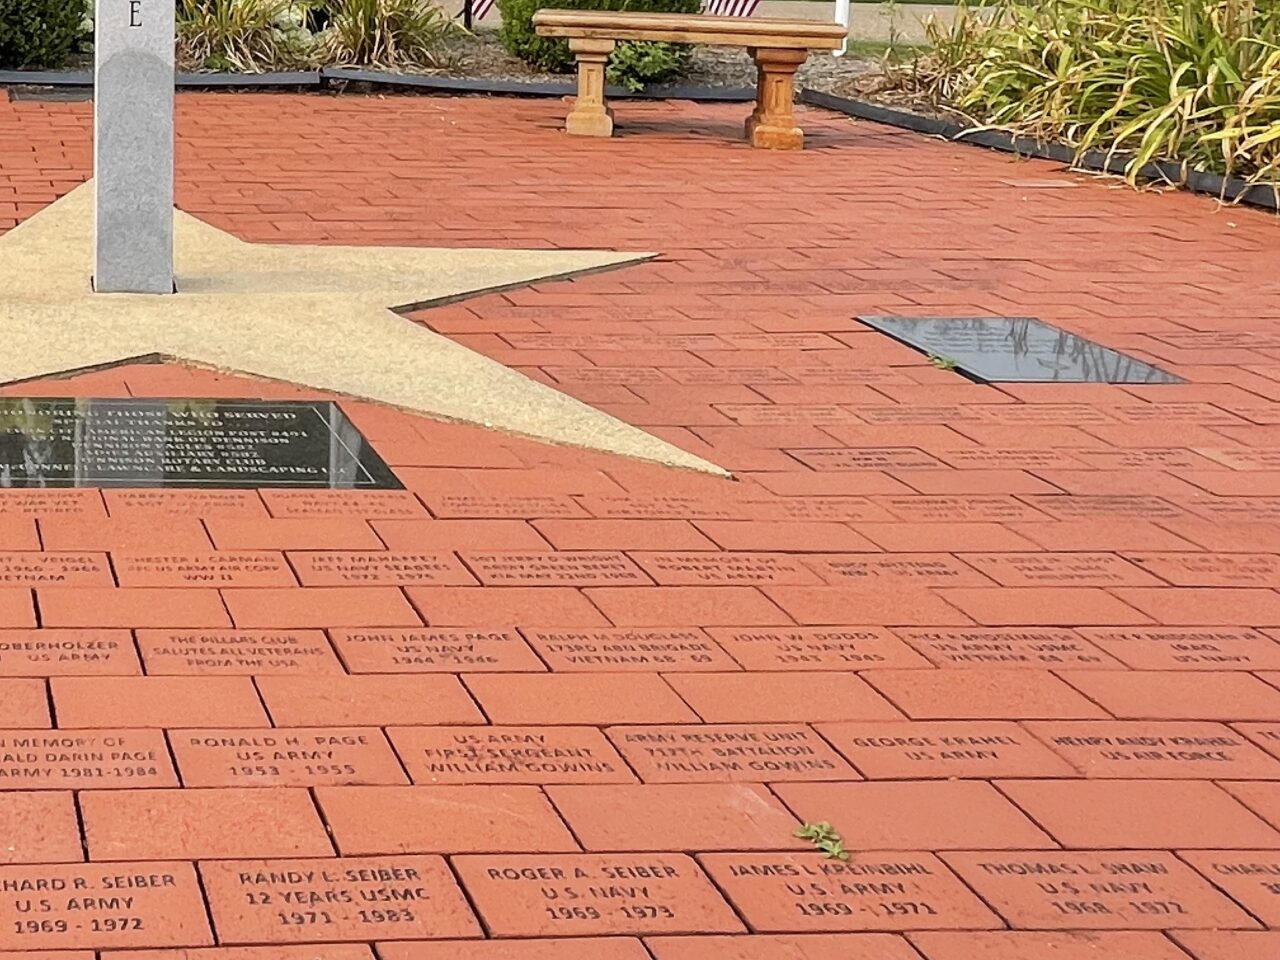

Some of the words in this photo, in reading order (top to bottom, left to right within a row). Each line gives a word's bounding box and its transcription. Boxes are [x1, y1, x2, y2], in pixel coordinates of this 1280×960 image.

[106, 410, 164, 418] THOSE
[223, 411, 296, 419] SERVED
[128, 419, 196, 427] THANKS
[89, 428, 166, 436] AMERICAN
[170, 429, 225, 437] LEGION
[207, 465, 318, 474] LANDSCAPING
[12, 736, 97, 749] MEMORY
[103, 737, 127, 748] OF
[315, 735, 369, 747] PAGE
[111, 751, 158, 762] PAGE
[236, 752, 266, 762] US
[273, 750, 335, 761] ARMY
[240, 870, 315, 886] RANDY
[345, 867, 420, 883] SEIBER
[487, 866, 564, 880] ROGER
[602, 865, 681, 879] SEIBER
[102, 875, 177, 889] SEIBER
[246, 892, 272, 906] 12
[279, 889, 354, 904] YEARS
[360, 887, 431, 902] USMC
[591, 886, 652, 899] NAVY
[840, 883, 907, 897] ARMY
[66, 897, 135, 911] ARMY
[14, 920, 69, 934] 1969
[90, 918, 146, 932] 1972
